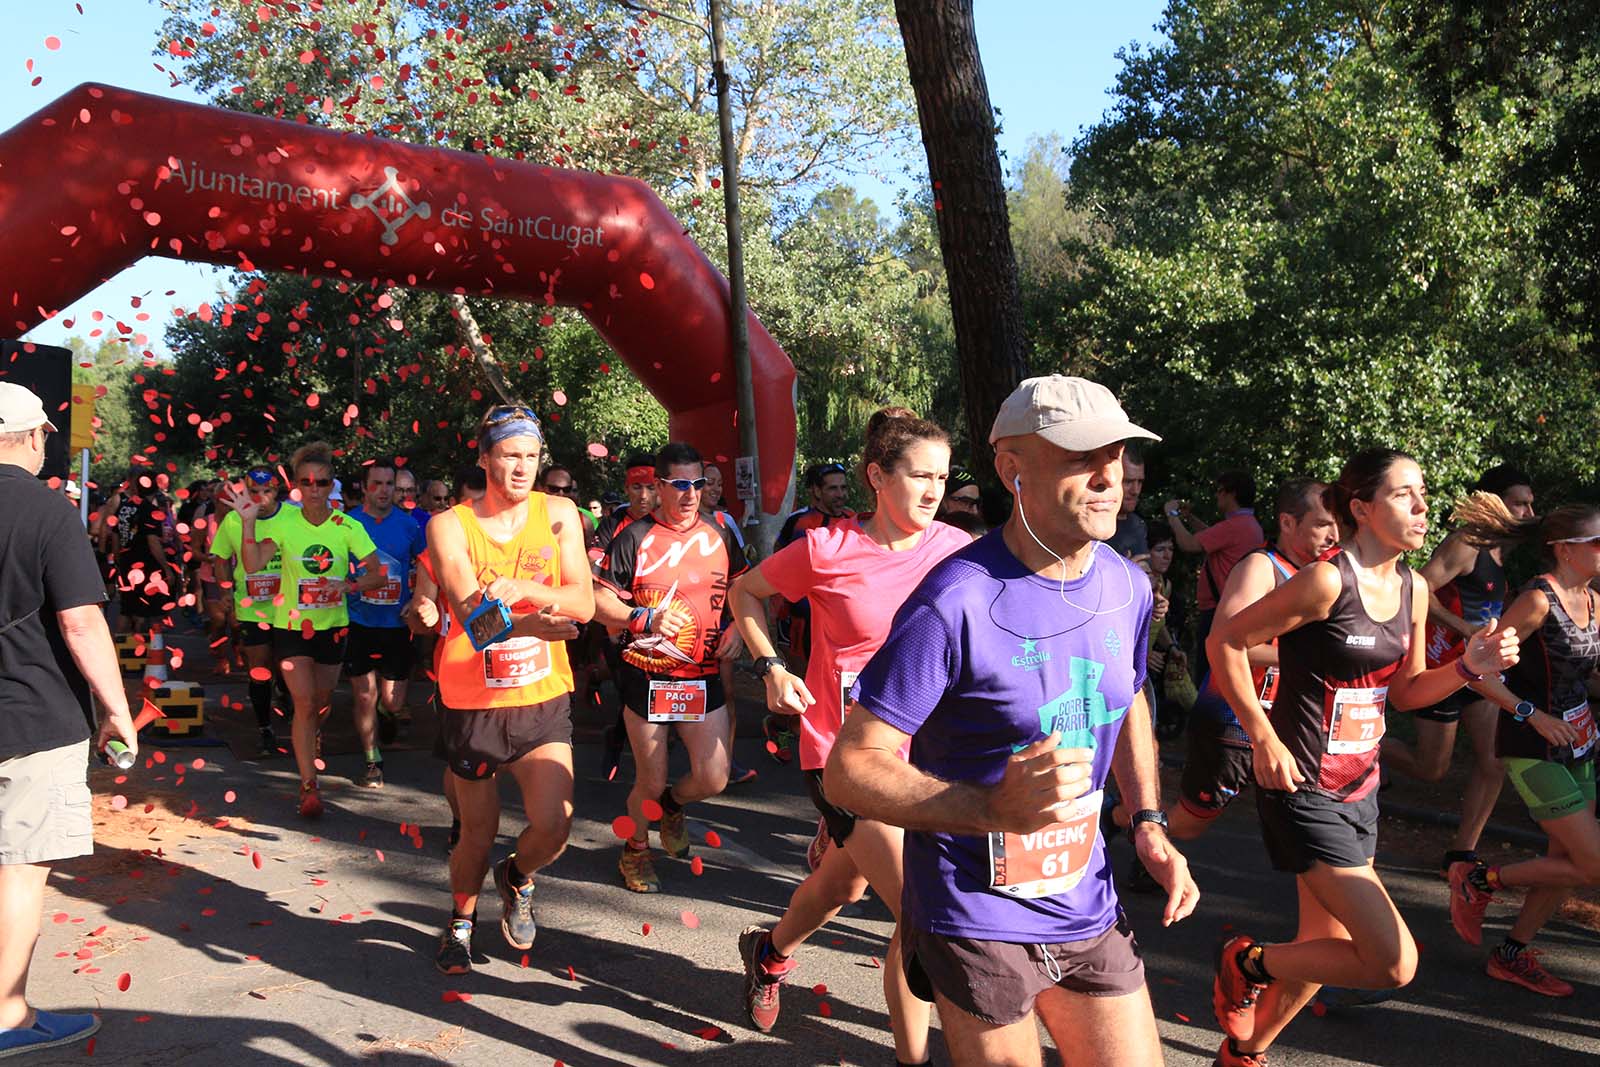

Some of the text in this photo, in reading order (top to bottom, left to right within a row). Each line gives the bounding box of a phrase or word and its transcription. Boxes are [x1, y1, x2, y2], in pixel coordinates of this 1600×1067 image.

[165, 158, 605, 249] Ajuntament de SantCugat
[509, 660, 537, 676] 224
[1011, 652, 1051, 667] Estrella
[665, 692, 694, 701] PACO
[671, 702, 687, 713] 90
[1058, 698, 1091, 716] CORRE
[1359, 722, 1376, 740] 72
[1021, 822, 1088, 851] VICENÇ
[1041, 850, 1070, 877] 61
